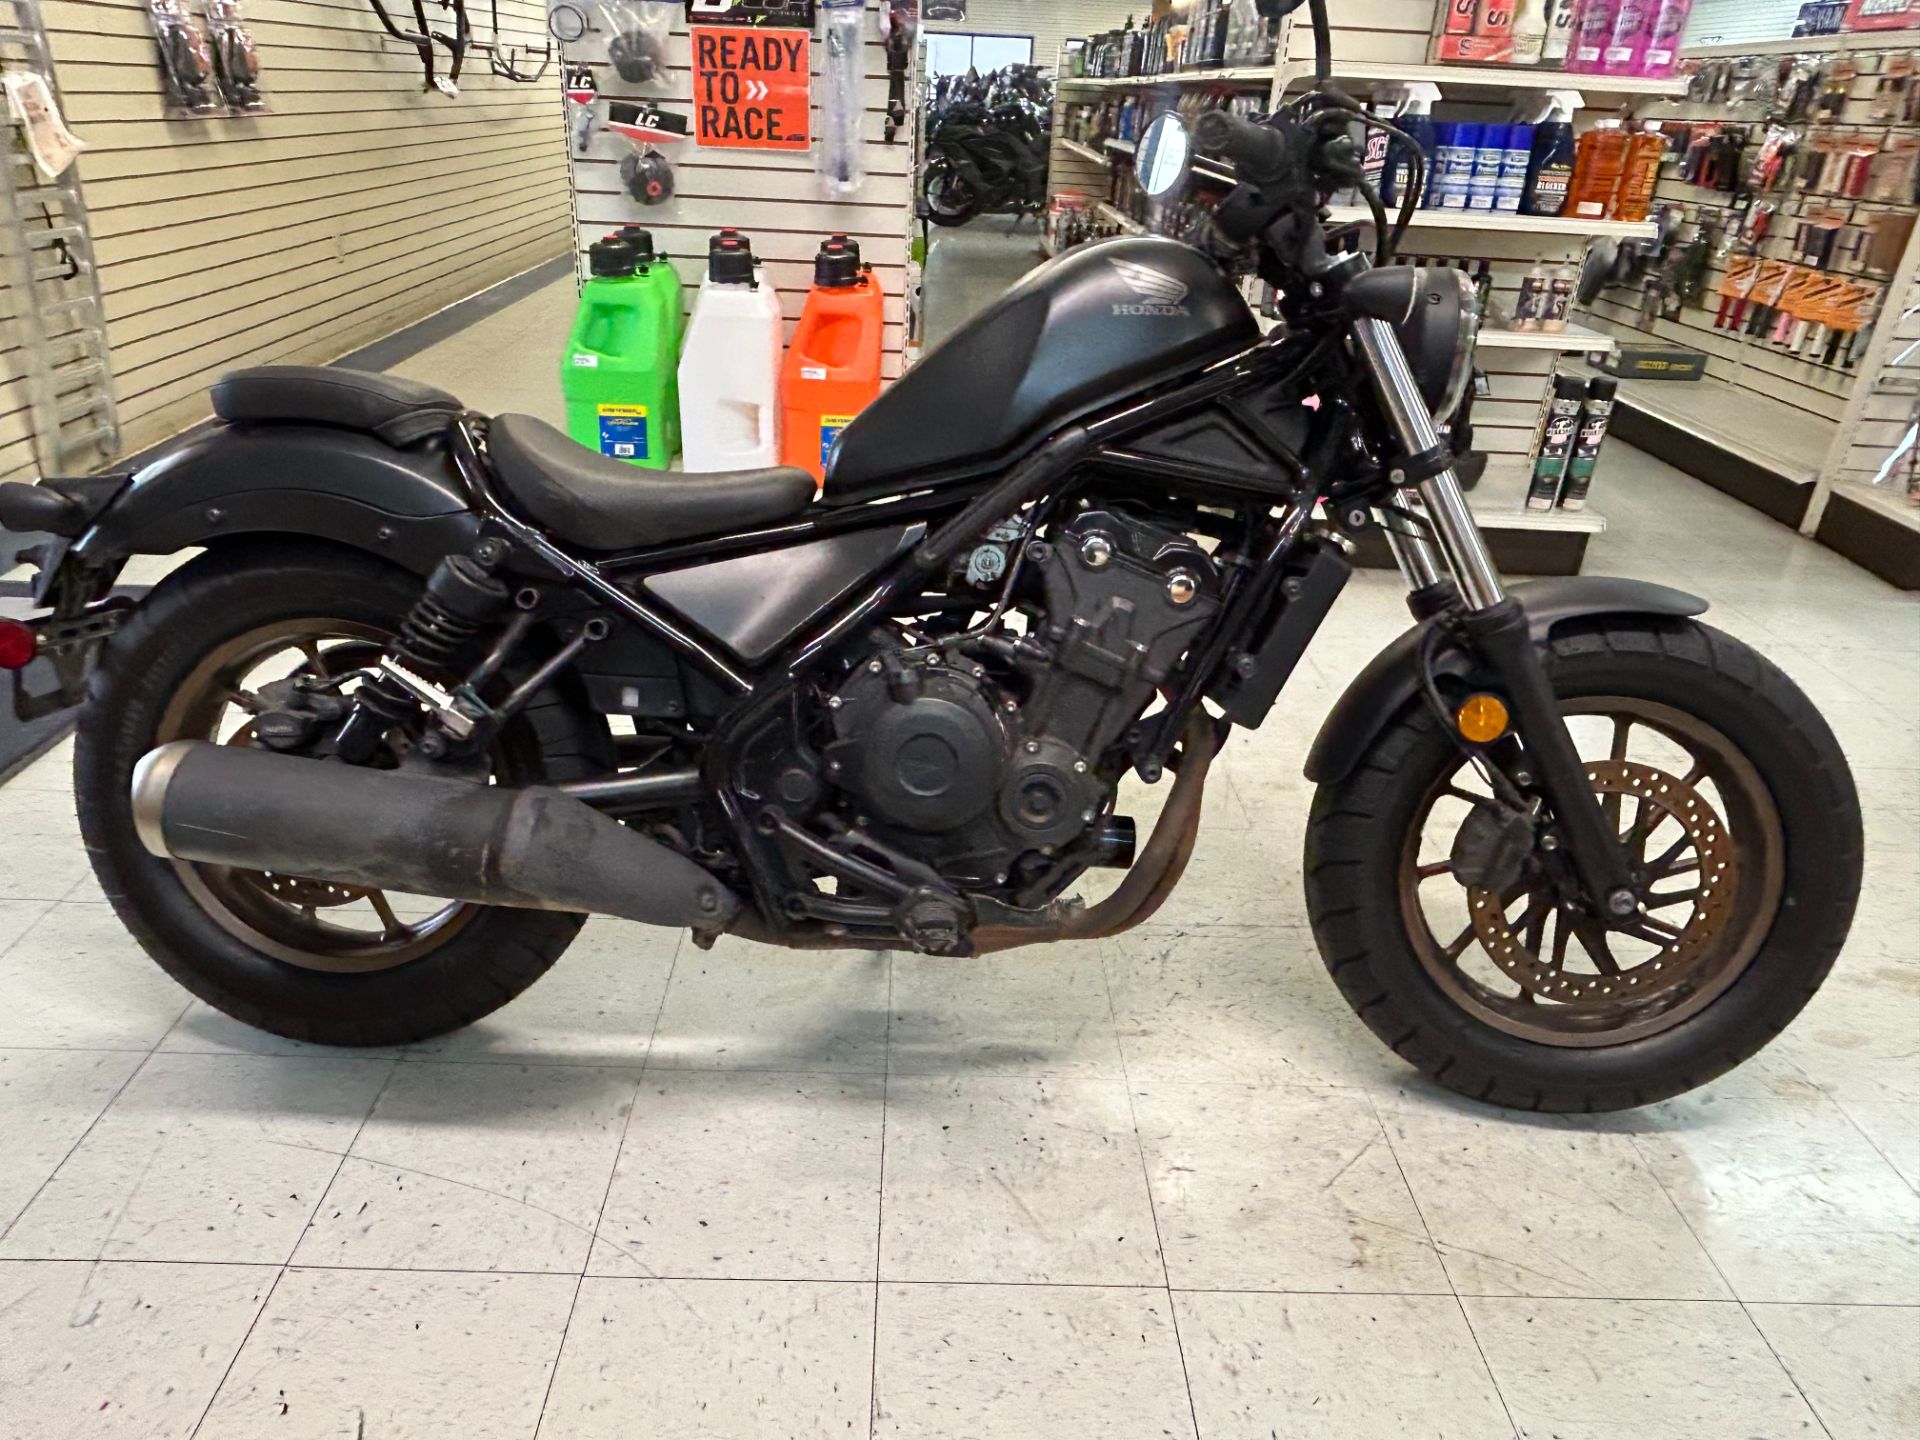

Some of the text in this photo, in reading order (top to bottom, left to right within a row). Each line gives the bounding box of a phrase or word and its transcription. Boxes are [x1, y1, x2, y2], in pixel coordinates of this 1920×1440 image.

[698, 34, 804, 72] READY
[569, 76, 592, 89] LC
[700, 70, 739, 105] TO
[634, 112, 660, 128] LC
[701, 105, 783, 141] RACE
[1111, 304, 1191, 317] HONDA
